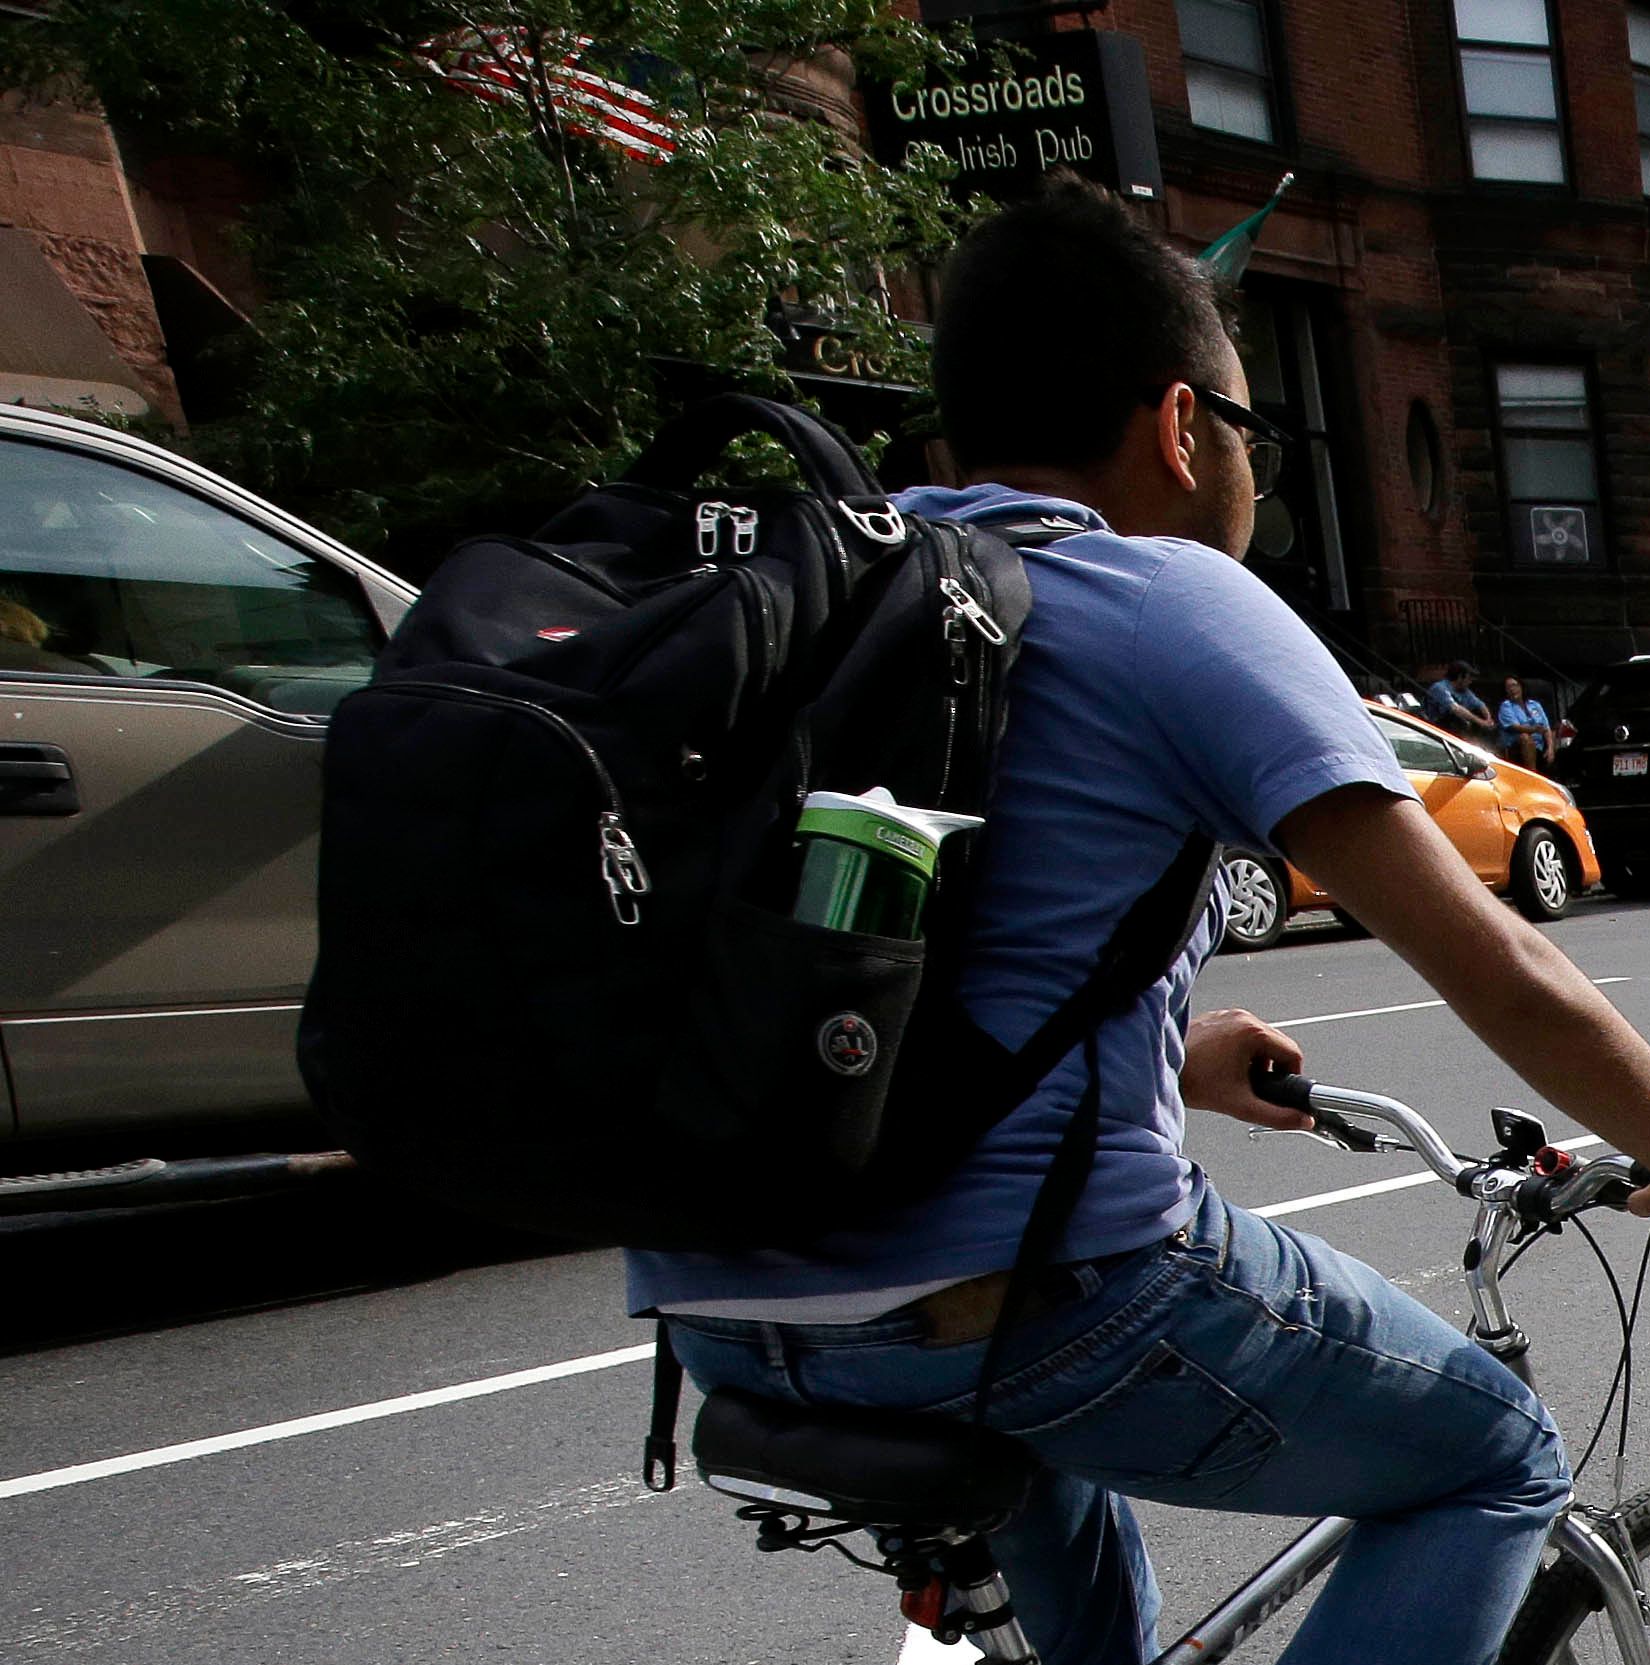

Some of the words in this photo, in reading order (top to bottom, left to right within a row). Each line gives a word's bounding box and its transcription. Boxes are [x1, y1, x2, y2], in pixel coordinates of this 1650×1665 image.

[891, 64, 1085, 121] Crossroads
[958, 133, 1017, 171] Irish
[1035, 126, 1093, 171] Pub
